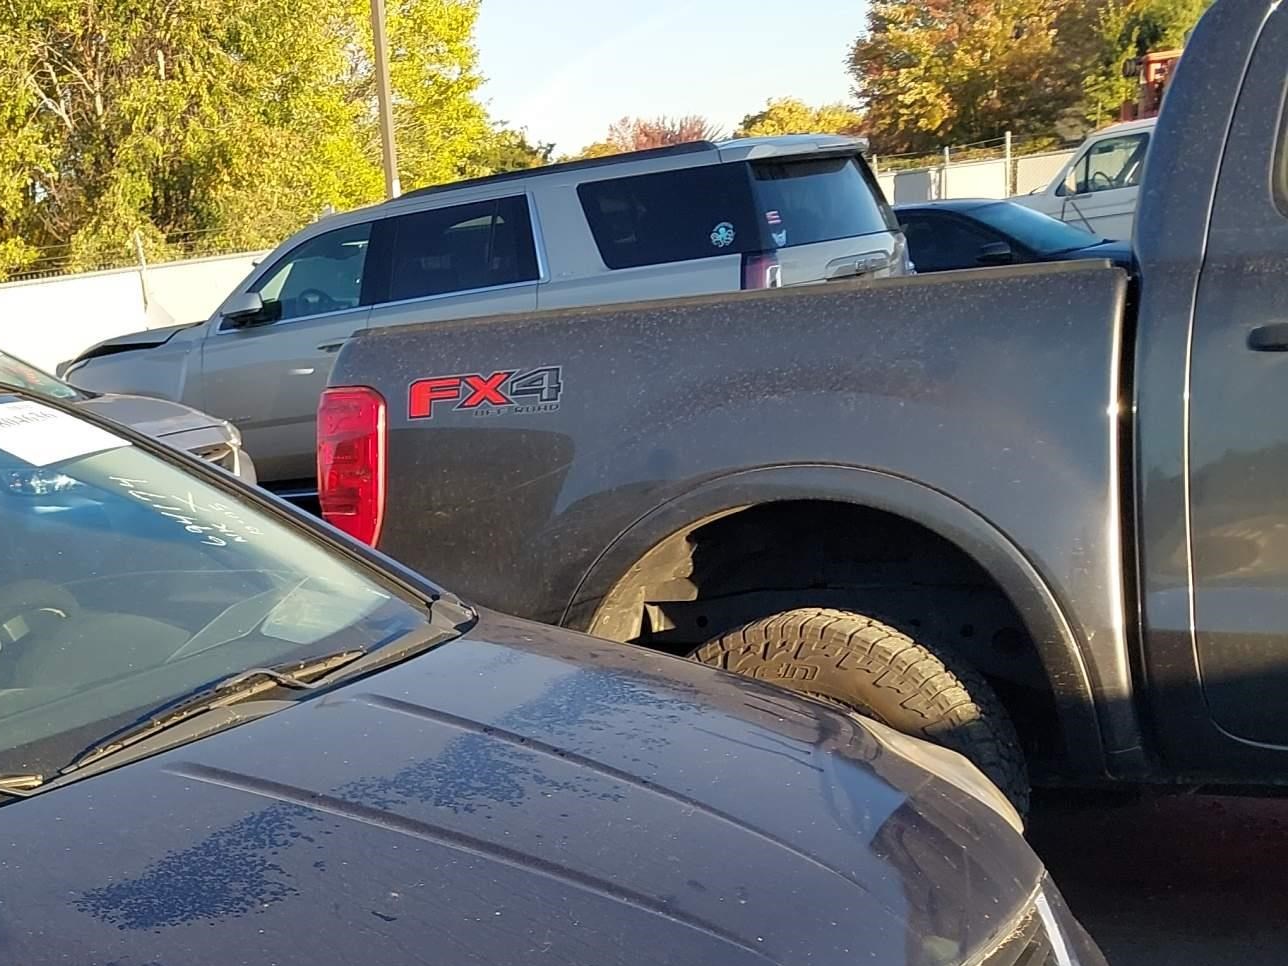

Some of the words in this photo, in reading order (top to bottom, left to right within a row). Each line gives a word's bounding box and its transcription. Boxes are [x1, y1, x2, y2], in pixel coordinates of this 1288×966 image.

[408, 365, 563, 421] FX4
[473, 408, 508, 418] OFF
[514, 403, 560, 415] ROAD
